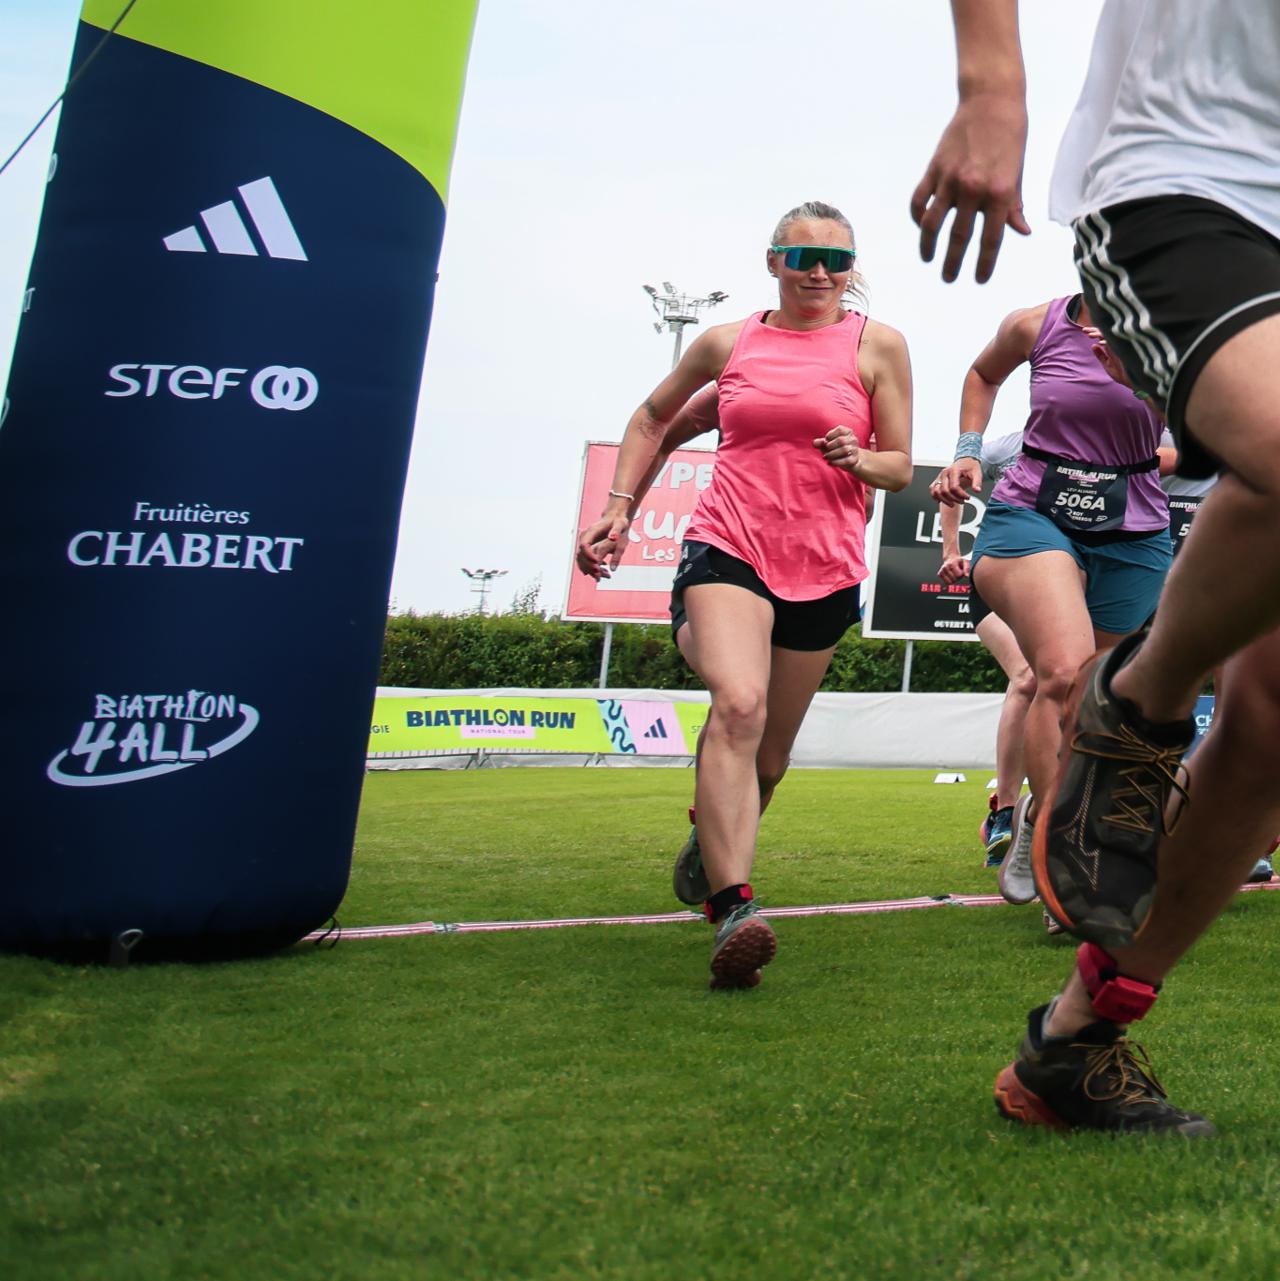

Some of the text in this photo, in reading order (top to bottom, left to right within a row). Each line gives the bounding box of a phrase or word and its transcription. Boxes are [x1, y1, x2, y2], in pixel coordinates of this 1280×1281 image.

[1054, 491, 1106, 511] 506A
[134, 502, 250, 524] Fruitières
[67, 530, 304, 573] CHABERT
[642, 545, 675, 563] Les
[406, 709, 576, 729] BIATHLON RUN
